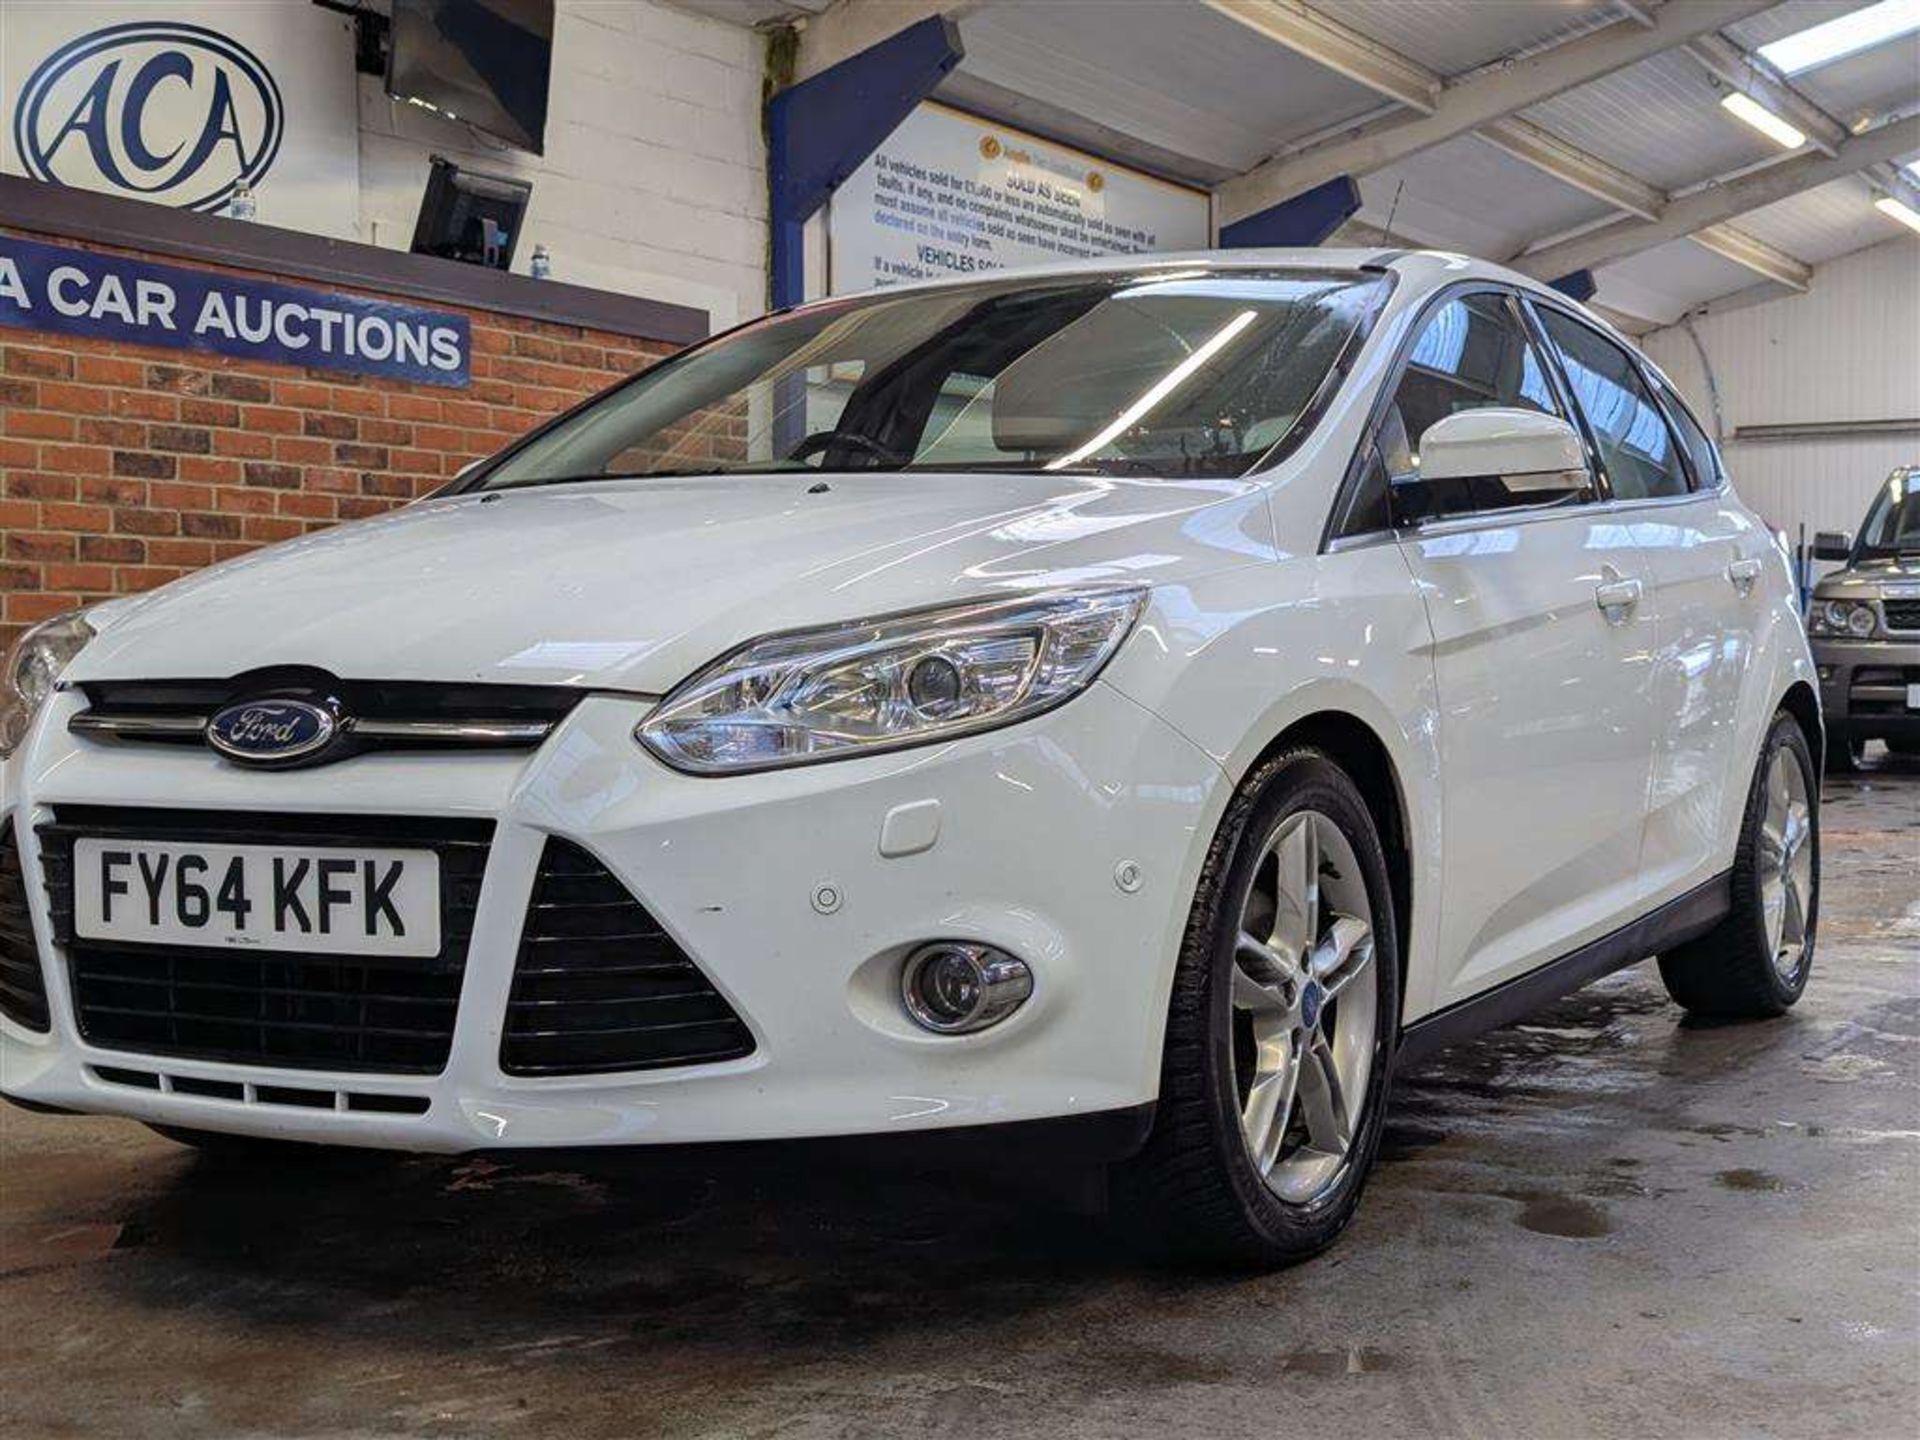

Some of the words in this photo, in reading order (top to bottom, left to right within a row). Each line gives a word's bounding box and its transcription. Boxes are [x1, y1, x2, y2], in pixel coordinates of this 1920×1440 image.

[40, 50, 252, 192] ACA
[889, 160, 927, 181] vehicles
[929, 171, 949, 187] sold
[937, 192, 954, 206] and
[987, 223, 1005, 237] sold
[892, 259, 923, 278] vehicle
[917, 242, 975, 273] VEHICLES
[47, 265, 177, 330] CAR
[194, 290, 462, 371] AUCTIONS
[228, 706, 301, 745] Ford
[101, 851, 252, 930] FY64
[272, 857, 406, 937] KFK
